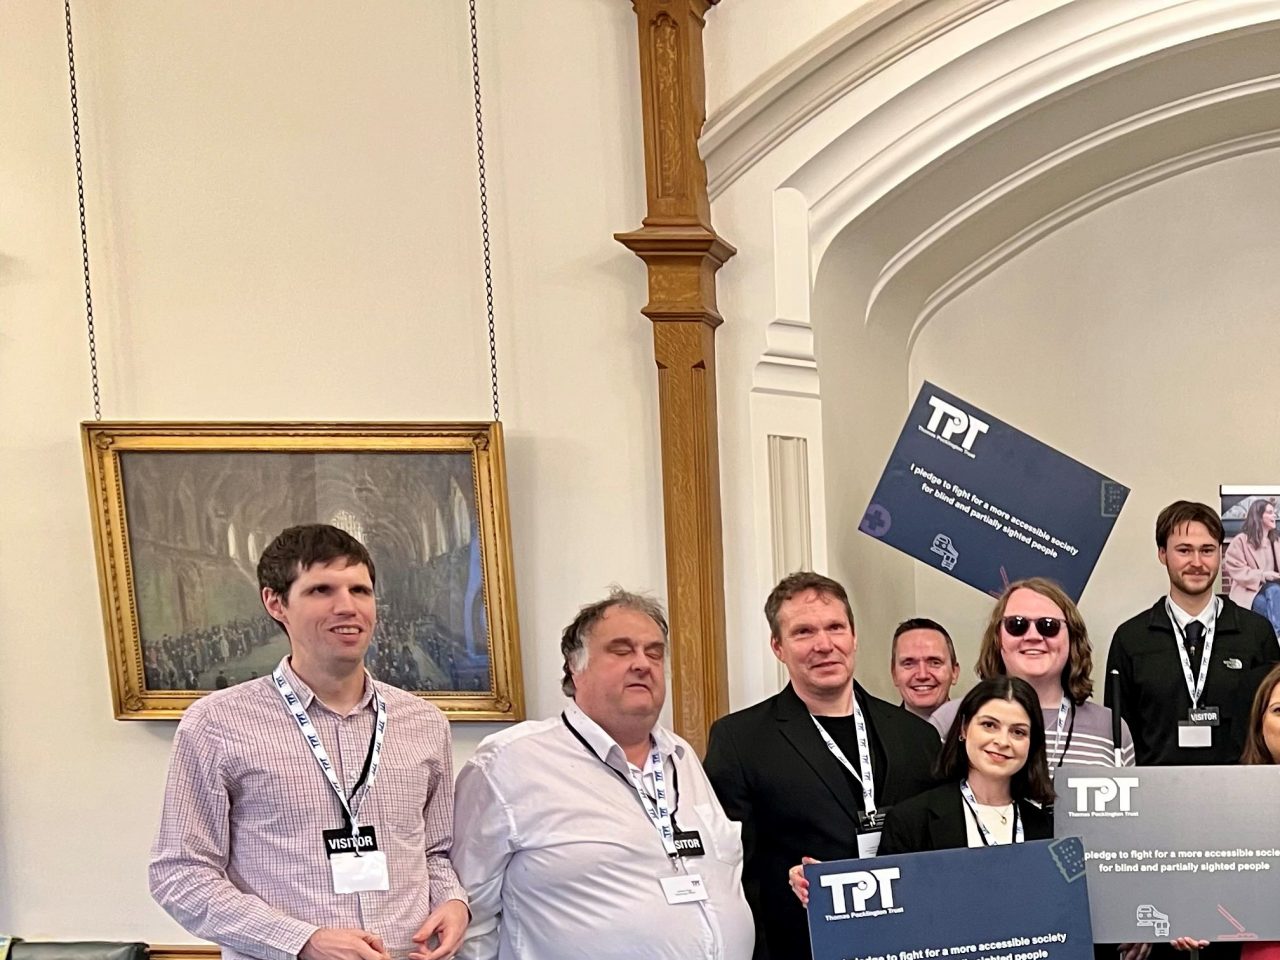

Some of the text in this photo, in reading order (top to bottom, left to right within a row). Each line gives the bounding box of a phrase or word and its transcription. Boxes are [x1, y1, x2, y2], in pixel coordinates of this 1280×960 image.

[928, 395, 990, 451] TPT
[910, 463, 1079, 556] I pledge to fight for a more accessible society
[921, 482, 1058, 558] for blind and partially sighted people
[296, 711, 308, 726] TPT
[1191, 712, 1217, 721] VISITOR
[1067, 777, 1139, 812] TPT
[328, 836, 373, 850] VISITOR
[674, 839, 701, 849] SITOR
[1084, 851, 1117, 861] pledge
[1118, 850, 1129, 859] to
[1130, 850, 1153, 860] fight
[1154, 849, 1168, 858] for
[1178, 850, 1203, 858] more
[1204, 848, 1254, 858] accessible
[1098, 861, 1270, 873] for blind and partially sighted people
[820, 867, 900, 914] TPT
[924, 948, 940, 958] for
[942, 947, 949, 956] a
[950, 945, 977, 955] more
[978, 937, 1031, 951] accessible
[1031, 932, 1067, 945] society
